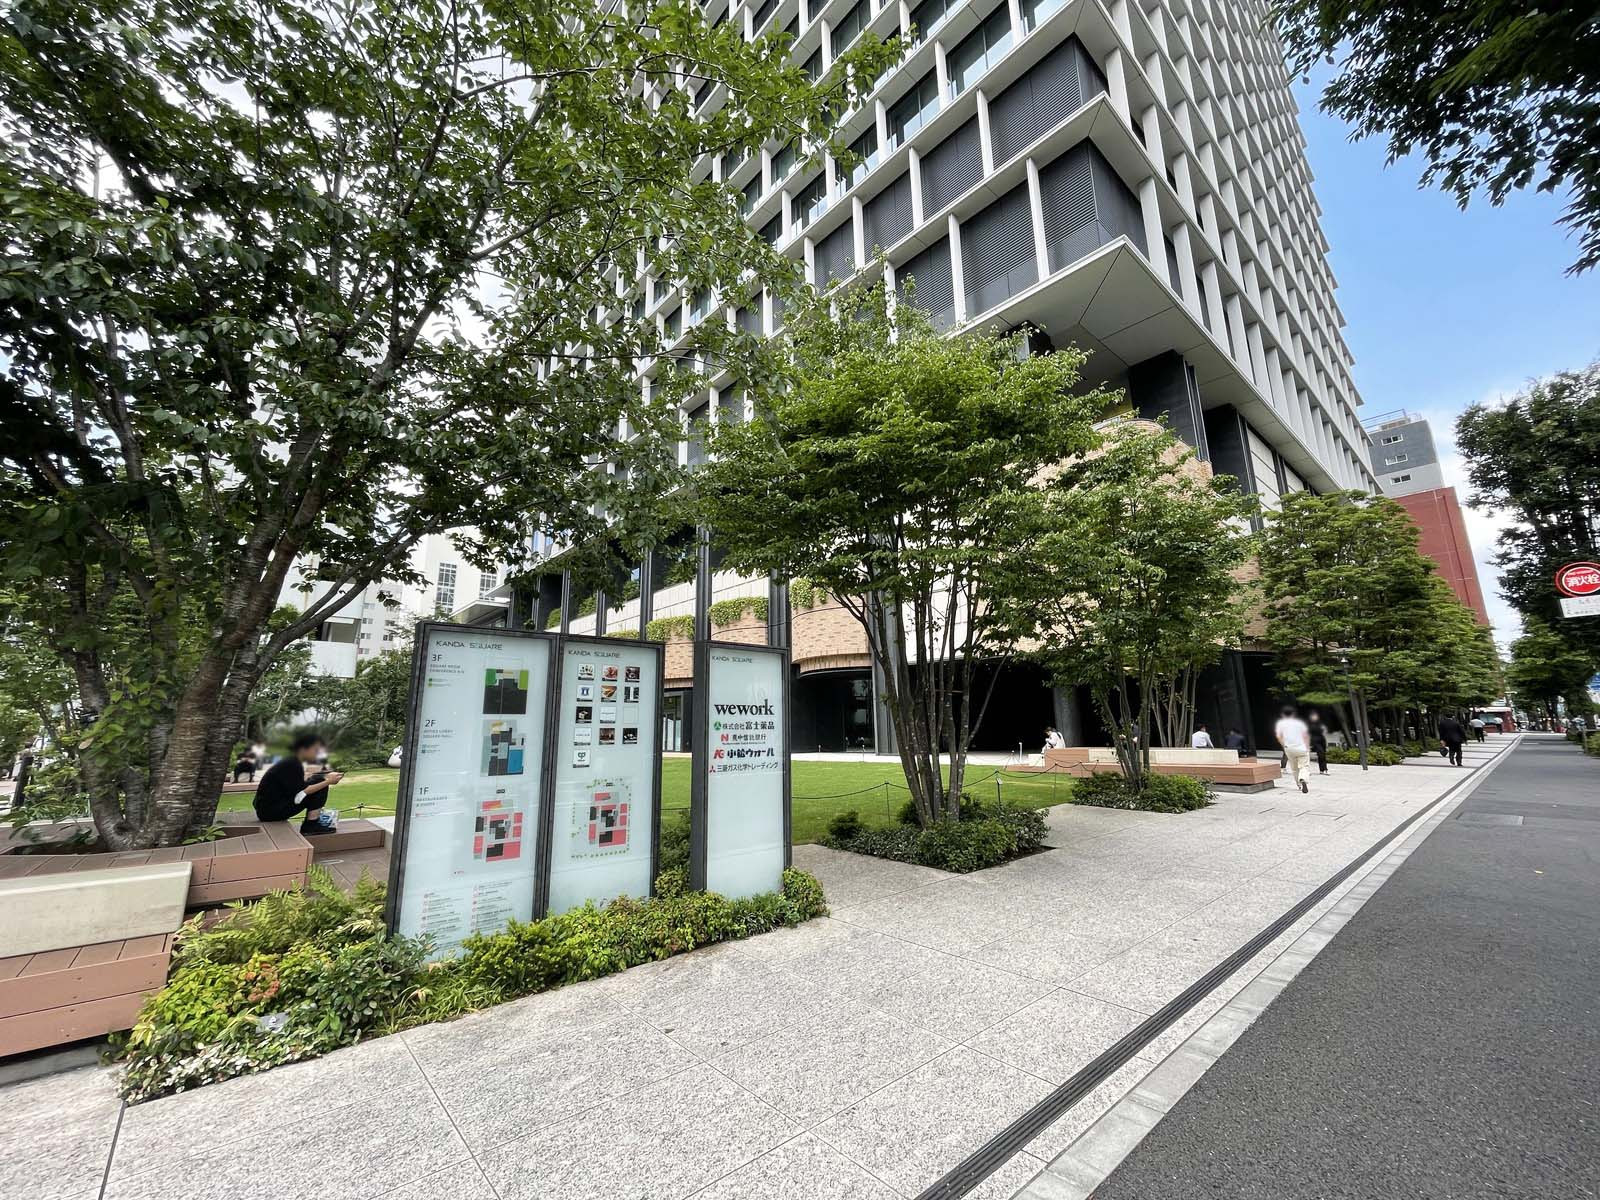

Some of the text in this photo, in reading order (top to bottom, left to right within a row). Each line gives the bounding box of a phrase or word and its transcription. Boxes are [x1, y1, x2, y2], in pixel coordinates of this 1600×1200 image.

[1567, 574, 1600, 587] 消火栓
[436, 640, 503, 650] KANDA SQUARE
[431, 654, 443, 662] 3F
[714, 699, 774, 715] wework
[424, 719, 436, 727] 2F
[419, 787, 429, 795] 1F
